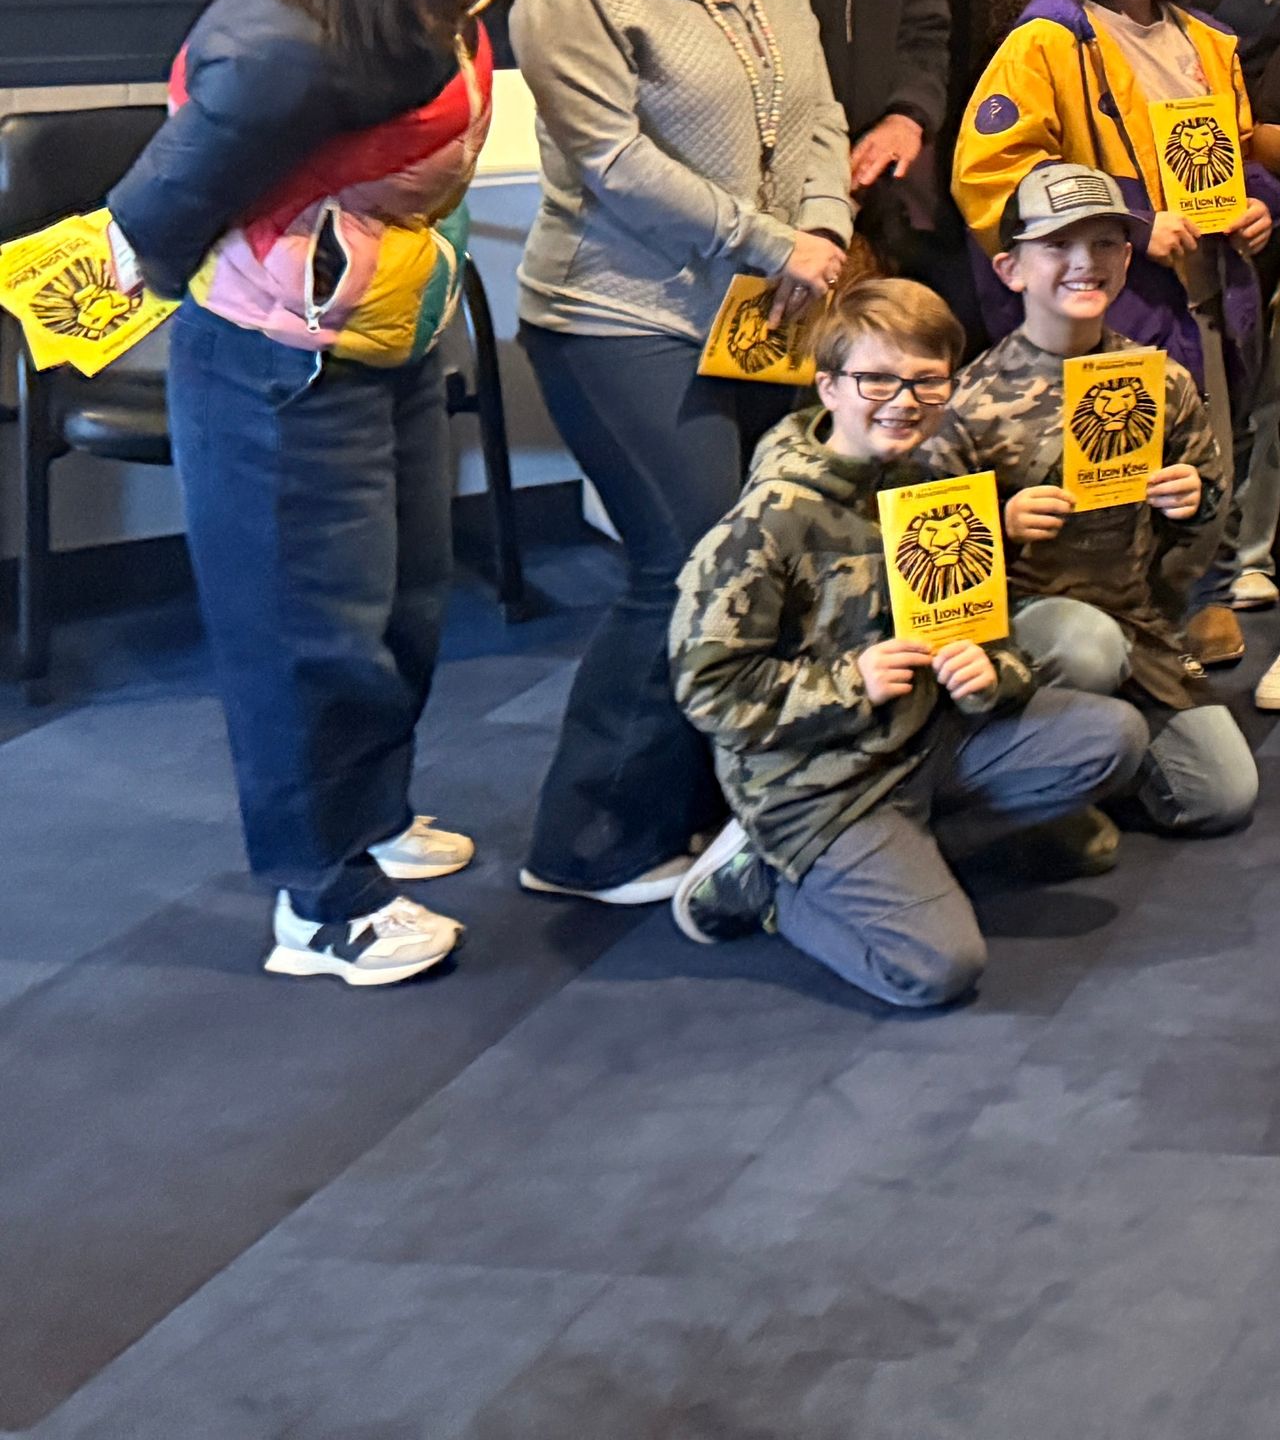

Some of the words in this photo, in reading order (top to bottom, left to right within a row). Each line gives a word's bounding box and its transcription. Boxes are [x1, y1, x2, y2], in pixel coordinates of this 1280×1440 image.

[1195, 197, 1214, 211] LION
[1214, 195, 1237, 208] KING
[1096, 464, 1120, 481] LION
[1121, 461, 1148, 478] KING
[911, 613, 932, 628] THE
[934, 606, 961, 625] LION
[963, 600, 994, 618] KING
